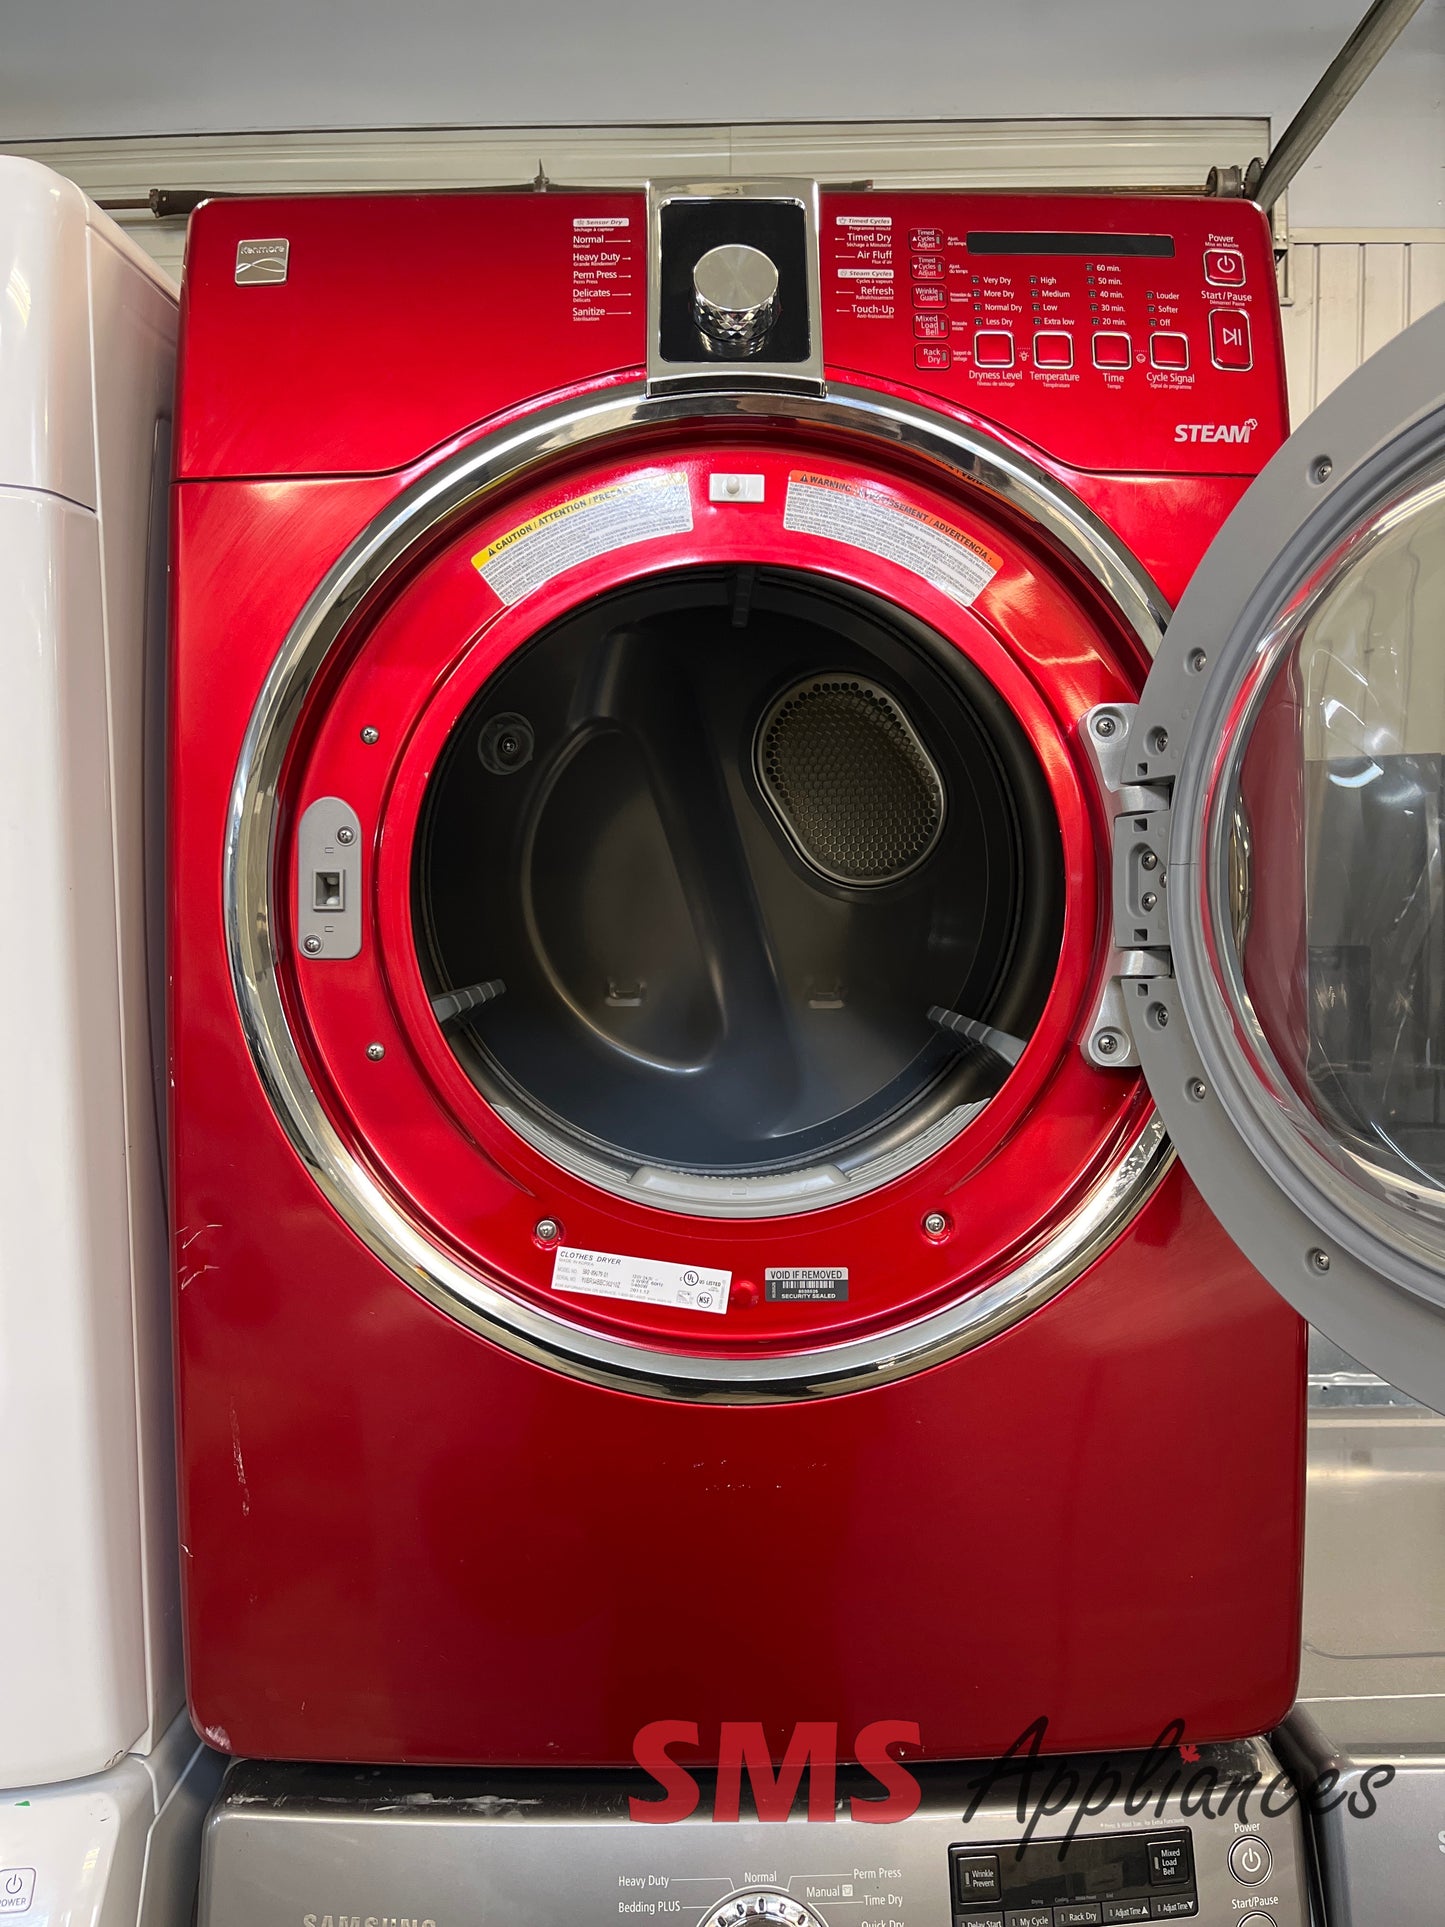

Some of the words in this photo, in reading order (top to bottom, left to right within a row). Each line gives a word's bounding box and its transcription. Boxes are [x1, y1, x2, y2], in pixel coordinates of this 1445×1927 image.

[573, 235, 604, 243] Normal
[847, 233, 874, 241] Timed
[877, 233, 892, 243] Dry
[1208, 234, 1234, 243] Power
[240, 246, 285, 254] Kenmore
[573, 253, 598, 262] Heavy
[600, 252, 620, 262] Duty
[857, 251, 870, 259] Air
[873, 251, 892, 259] Fluff
[1106, 264, 1121, 272] min.
[573, 271, 594, 279] Perm
[596, 270, 617, 279] Press
[983, 277, 998, 285] Very
[999, 277, 1011, 285] Dry
[1040, 276, 1056, 285] High
[573, 288, 611, 297] Delicates
[861, 286, 894, 295] Refresh
[1003, 291, 1014, 299] Dry
[1110, 291, 1124, 299] min.
[1157, 292, 1179, 300] Louder
[572, 307, 605, 316] Sanitize
[851, 304, 895, 315] Touch-Up
[1011, 304, 1022, 312] Dry
[1101, 304, 1110, 312] 30
[1111, 304, 1126, 312] min.
[1001, 318, 1013, 326] Dry
[1112, 318, 1126, 326] min.
[928, 356, 940, 364] Dry
[969, 370, 1000, 381] Dryness
[1002, 371, 1022, 380] Level
[1030, 371, 1080, 382] Temperature
[1103, 374, 1124, 382] Time
[1146, 373, 1168, 384] Cycle
[1170, 374, 1195, 384] Signal
[1174, 424, 1250, 443] STEAM
[810, 476, 851, 492] WARNING
[933, 521, 988, 560] ADVERTENCIA
[495, 524, 532, 550] CAUTION
[537, 500, 586, 526] ATTENTION
[560, 1251, 593, 1261] CLOTHES
[597, 1257, 621, 1265] DRYER
[770, 1271, 790, 1279] VOID
[792, 1271, 800, 1279] IF
[801, 1270, 842, 1279] REMOVED
[699, 1296, 710, 1304] NSF
[1234, 1823, 1260, 1833] Power
[1161, 1848, 1180, 1857] Mixed
[1162, 1858, 1177, 1867] Load
[853, 1868, 876, 1879] Perm
[878, 1867, 902, 1878] Press
[971, 1870, 994, 1878] Wrinkle
[1163, 1867, 1175, 1876] Bell
[744, 1870, 777, 1883] Normal
[618, 1876, 645, 1888] Heavy
[648, 1875, 669, 1888] Duty
[973, 1880, 994, 1888] Prevent
[806, 1886, 840, 1898] Manual
[0, 1898, 26, 1907] OWER
[864, 1895, 885, 1906] Time
[888, 1894, 903, 1907] Dry
[1231, 1896, 1279, 1909] Start/Pause
[618, 1901, 655, 1915] Bedding
[657, 1901, 681, 1912] PLUS
[1163, 1904, 1177, 1912] Adjust
[1177, 1902, 1188, 1910] Time
[1069, 1912, 1085, 1920] Rack
[1086, 1912, 1097, 1921] Dry
[1115, 1908, 1129, 1918] Adjust
[1020, 1918, 1030, 1927] My
[1032, 1916, 1049, 1926] Cycle
